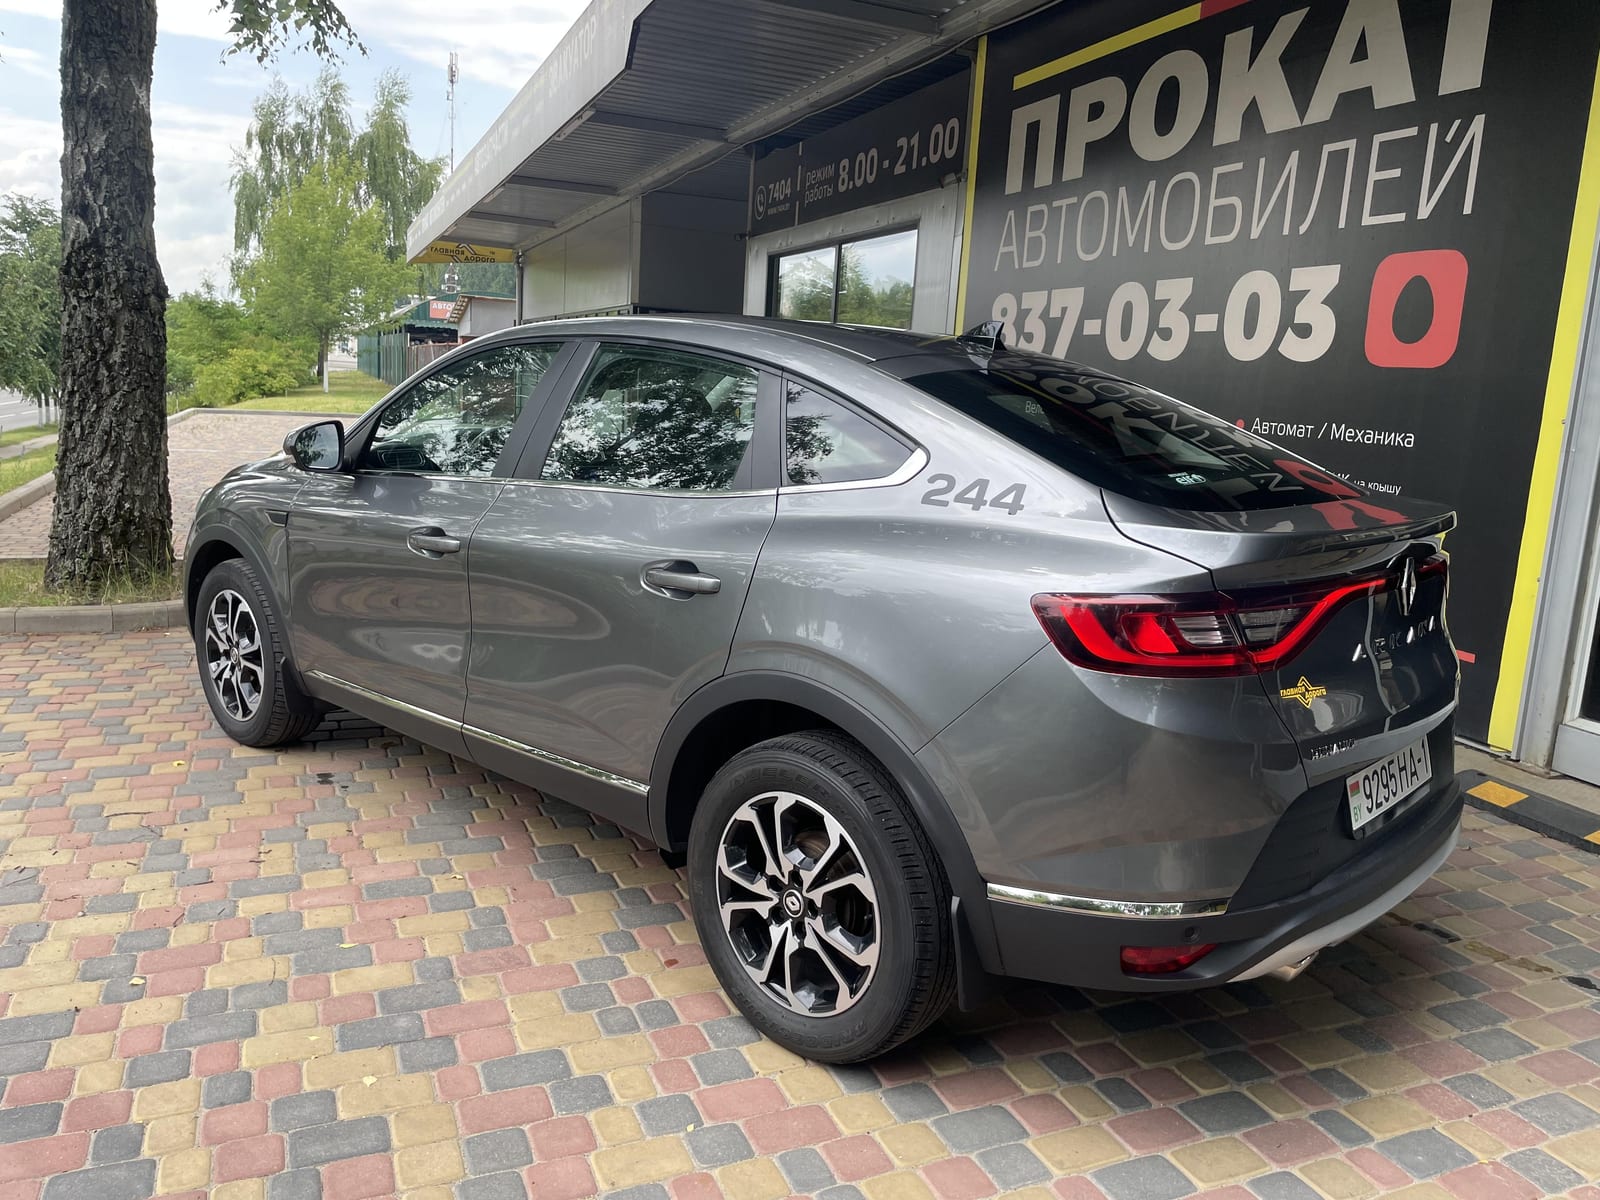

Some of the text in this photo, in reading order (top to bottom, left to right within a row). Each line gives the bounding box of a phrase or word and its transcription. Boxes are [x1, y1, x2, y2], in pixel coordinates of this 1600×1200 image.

[838, 147, 878, 193] 8.00
[893, 117, 960, 176] 21.00
[768, 176, 792, 204] 7404
[805, 163, 835, 190] режим
[804, 183, 834, 208] работы
[994, 114, 1486, 272] АВТОМОБИЛЕЙ
[991, 264, 1341, 362] 837-03-03
[1250, 417, 1315, 438] Автомат
[1330, 422, 1415, 448] Механика
[920, 473, 1027, 515] 244
[1353, 803, 1362, 822] BY
